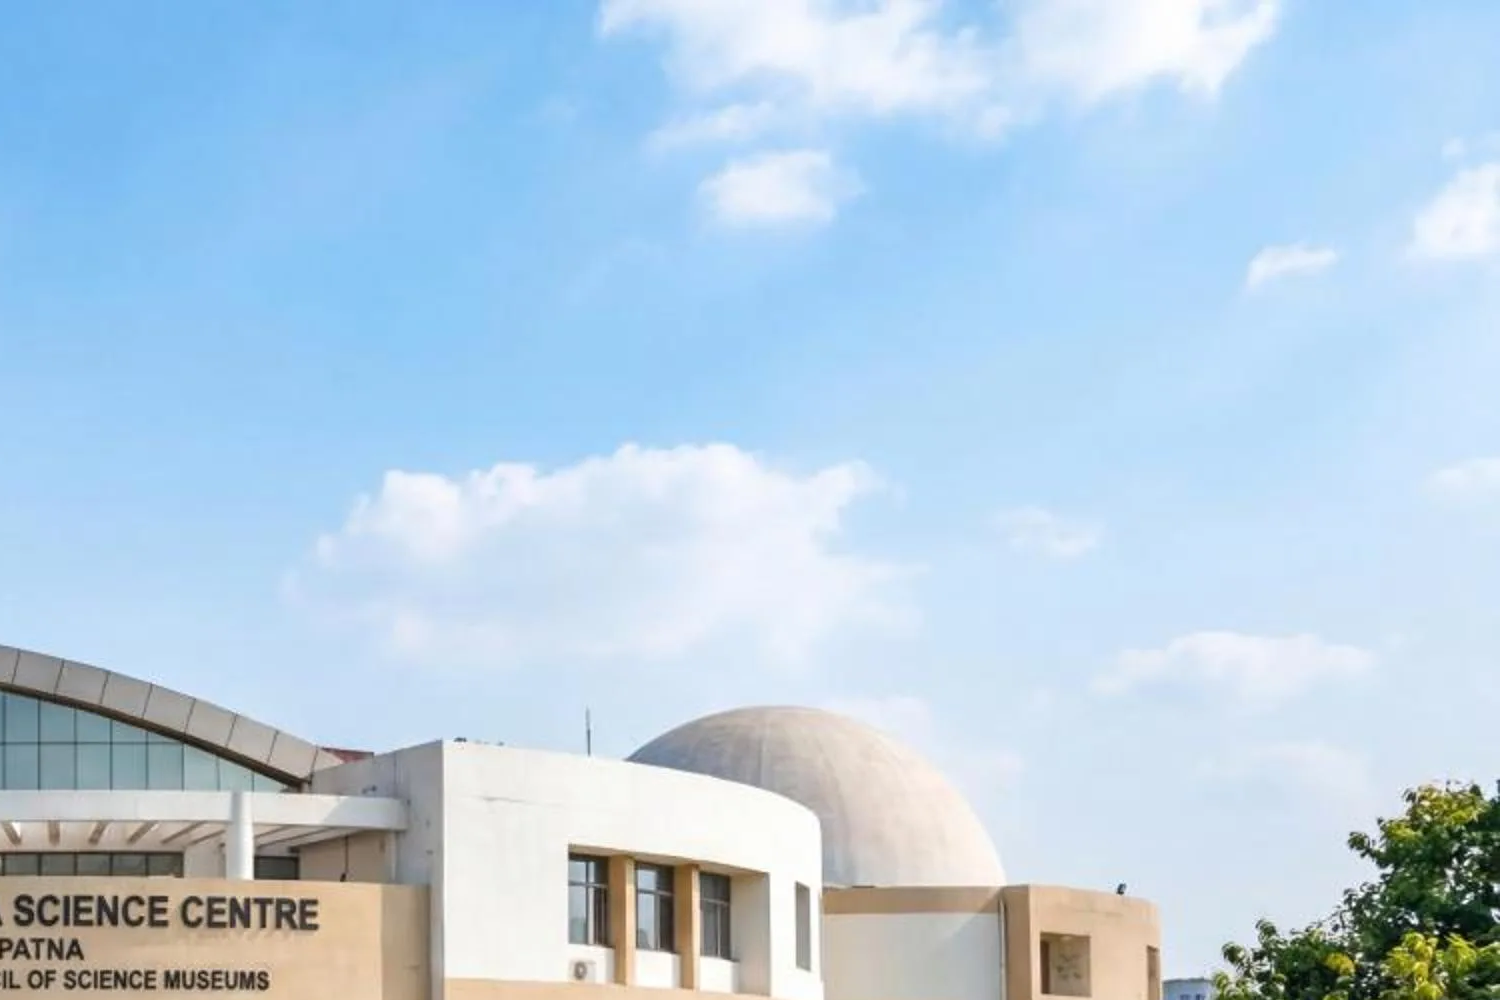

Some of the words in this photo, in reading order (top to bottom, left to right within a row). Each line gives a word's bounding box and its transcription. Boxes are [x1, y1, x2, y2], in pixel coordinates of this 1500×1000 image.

[13, 893, 169, 928] SCIENCE
[180, 895, 319, 931] CENTRE
[27, 969, 57, 990] OF
[63, 969, 157, 991] SCIENCE
[163, 969, 270, 991] MUSEUMS
